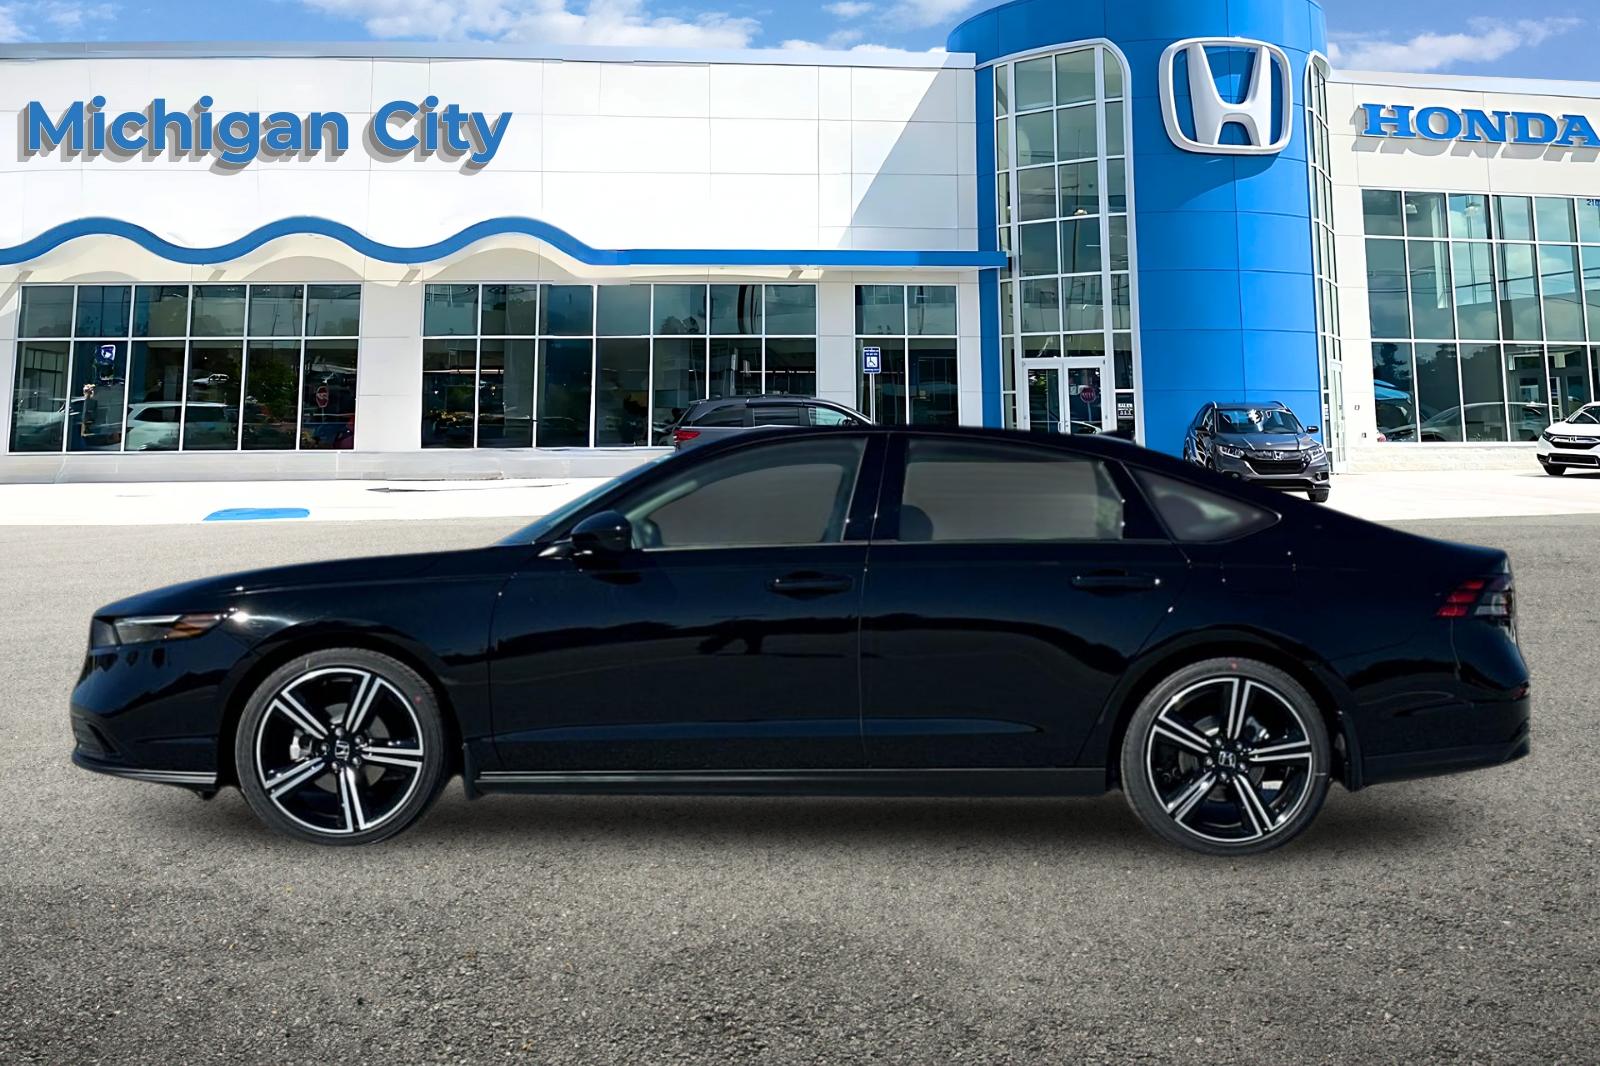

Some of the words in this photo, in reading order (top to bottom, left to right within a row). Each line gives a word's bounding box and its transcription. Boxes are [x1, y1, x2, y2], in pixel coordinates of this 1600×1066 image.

[28, 95, 349, 164] Michigan
[373, 95, 513, 164] City
[1361, 103, 1600, 147] HONDA
